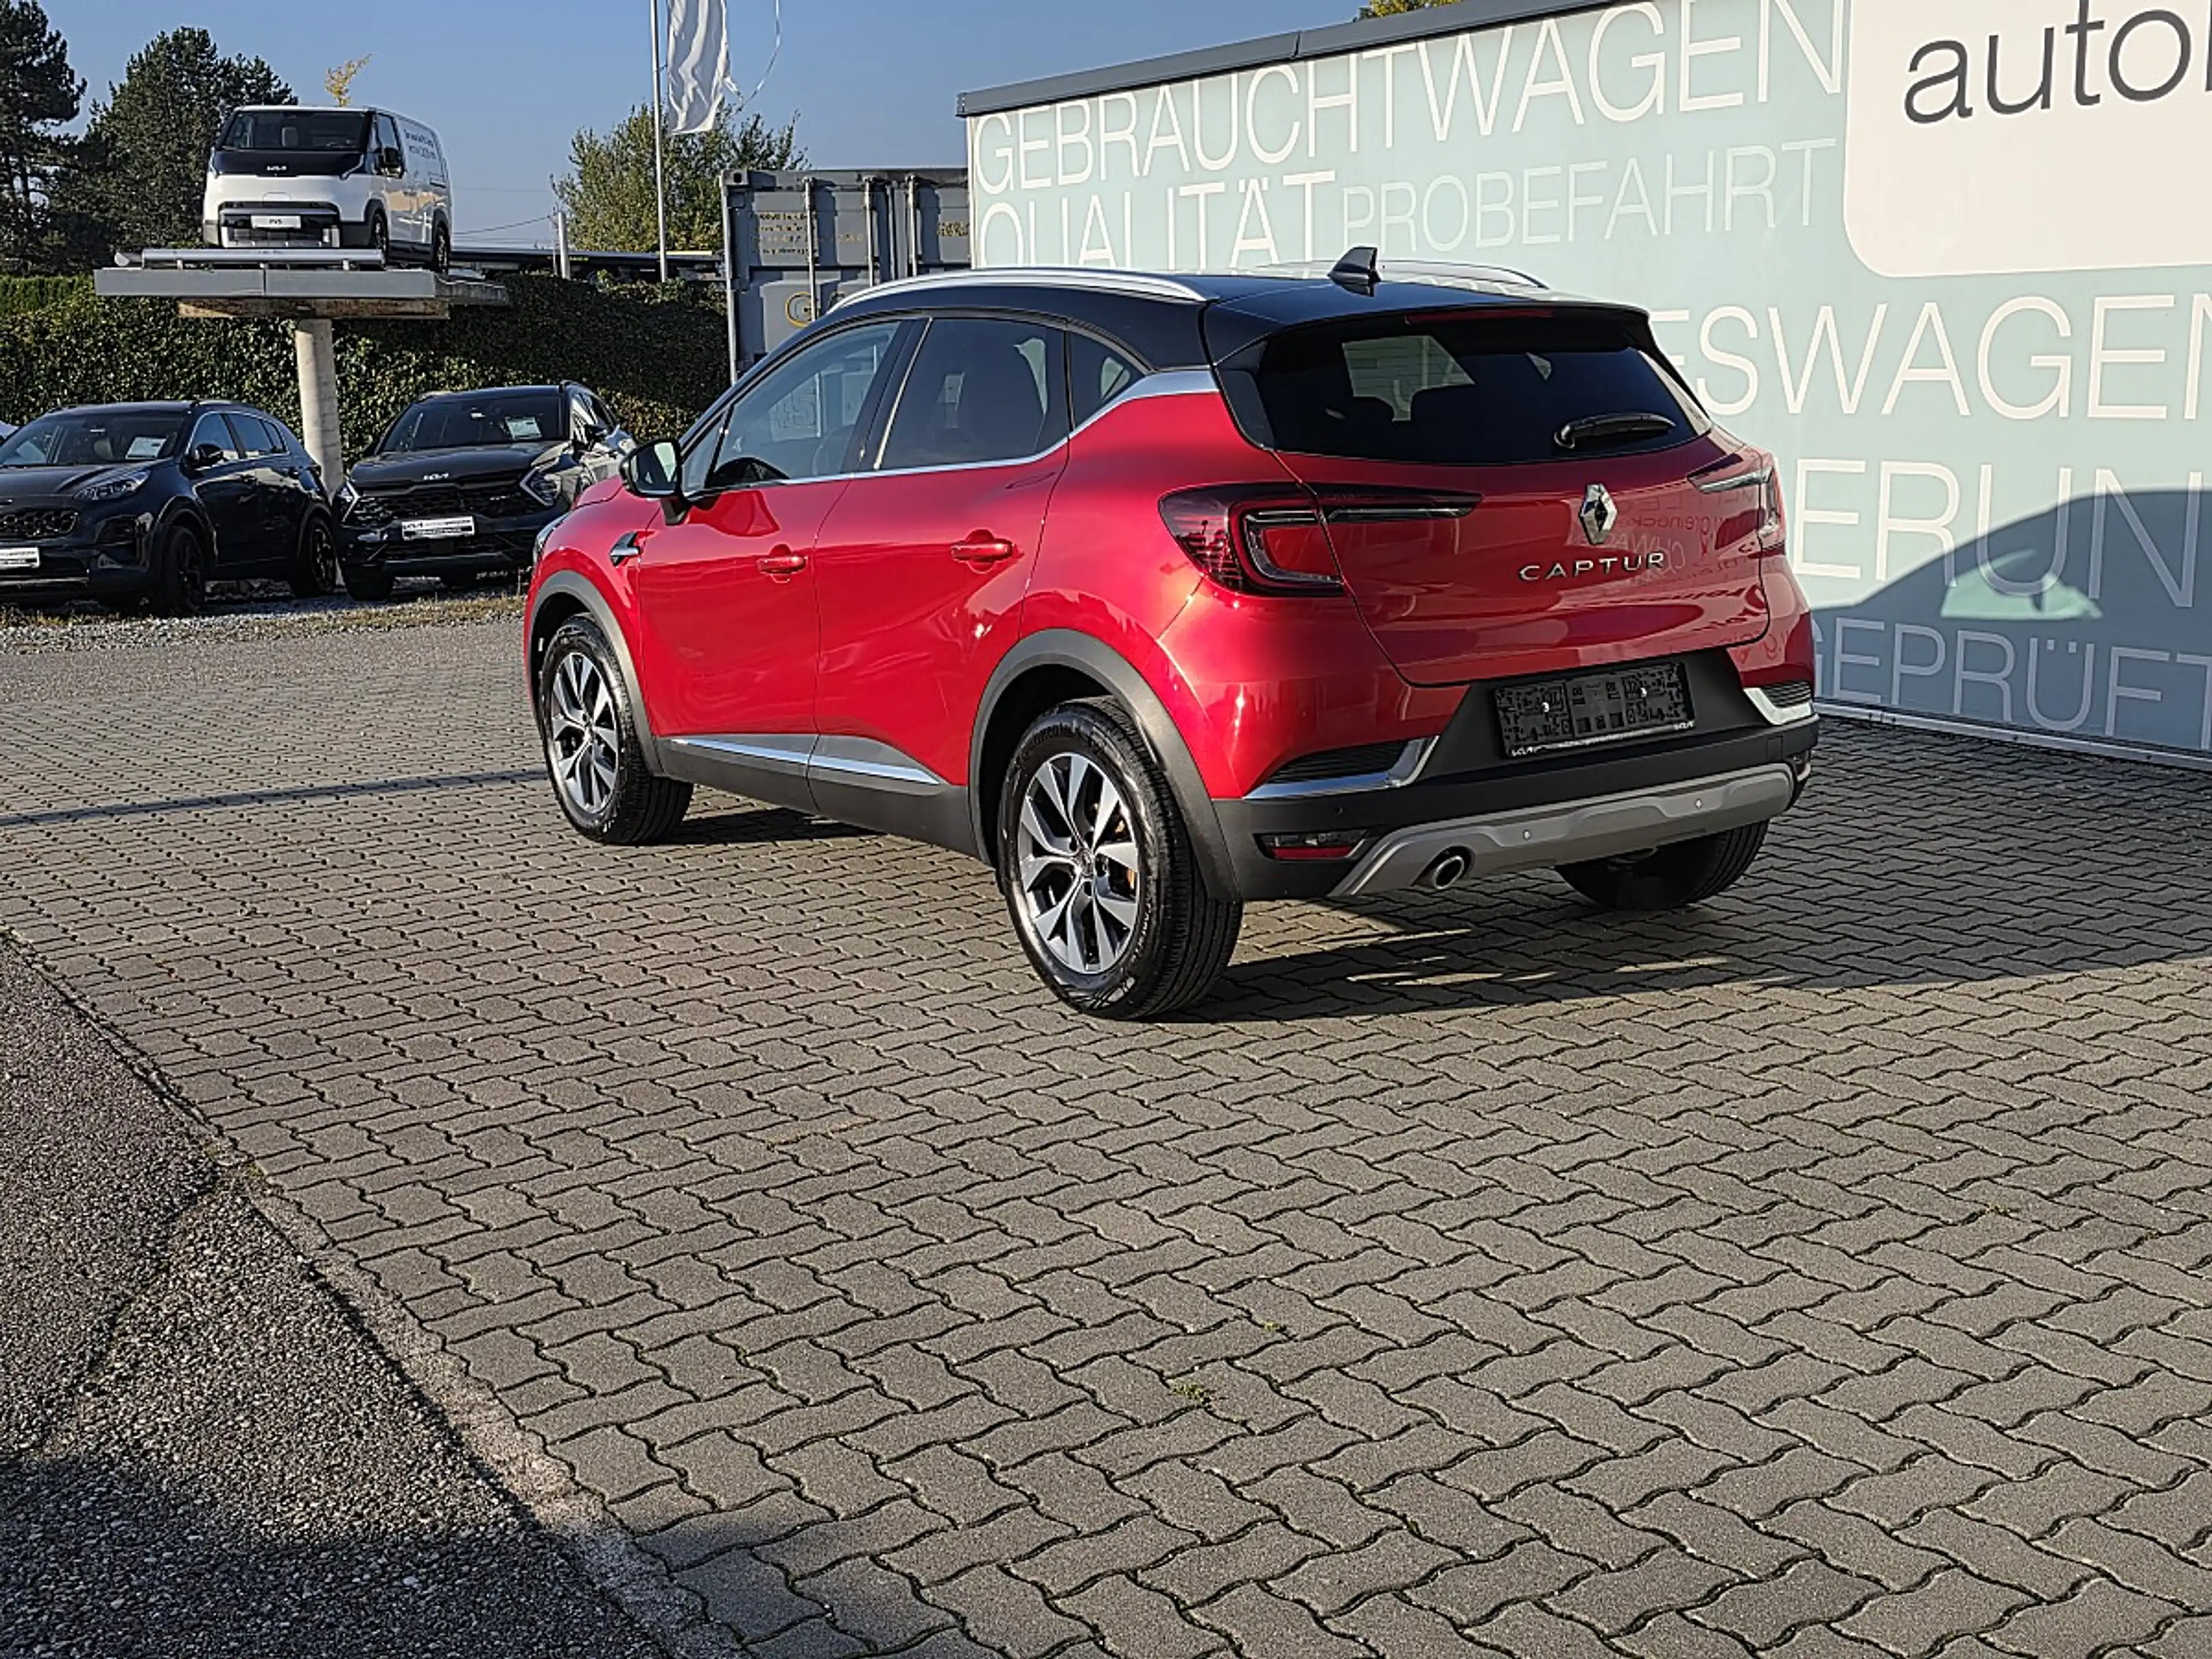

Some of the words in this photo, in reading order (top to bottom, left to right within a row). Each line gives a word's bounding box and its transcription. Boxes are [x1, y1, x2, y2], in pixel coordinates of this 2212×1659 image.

[974, 0, 1845, 195] GEBRAUCHTWAGEN
[1904, 0, 2212, 124] auto
[1343, 138, 1836, 252] PROBEFAHRT
[1518, 552, 1666, 582] CAPTUR
[1794, 459, 2202, 608] ERUN
[1813, 617, 2212, 750] EPRÜFT
